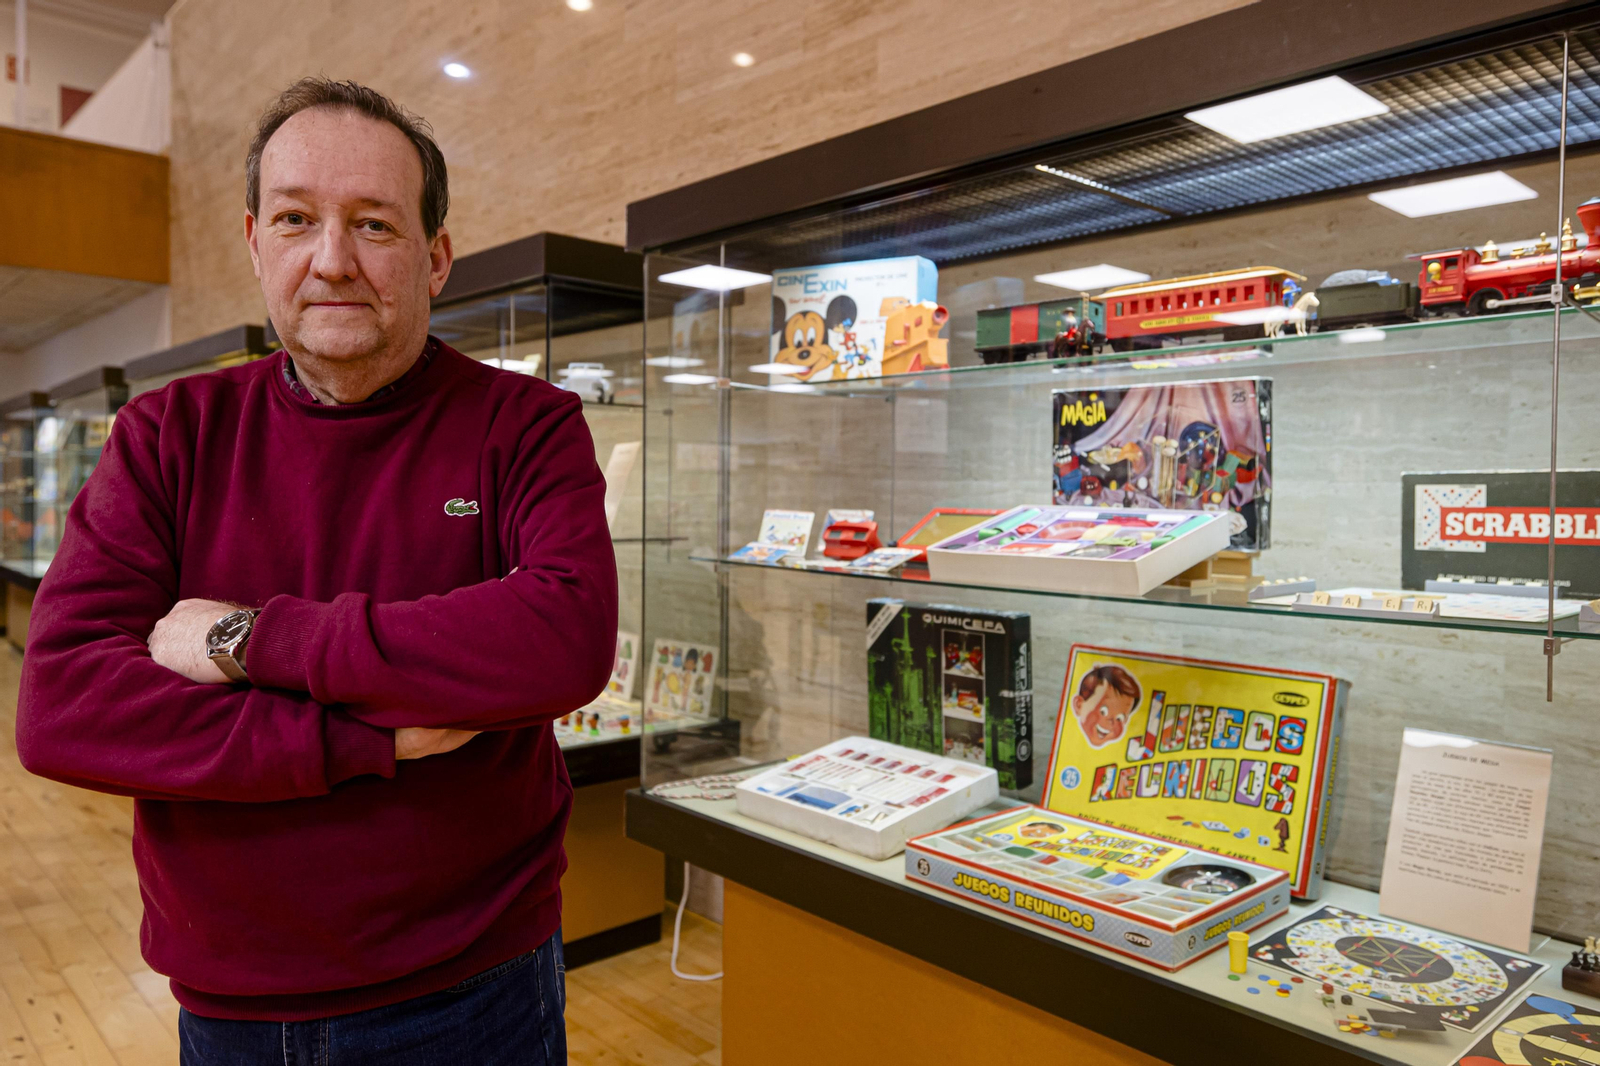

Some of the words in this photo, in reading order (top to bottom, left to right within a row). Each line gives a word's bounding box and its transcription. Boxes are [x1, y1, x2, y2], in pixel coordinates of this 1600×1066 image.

[922, 612, 1006, 635] QUIMICEFA
[1125, 689, 1308, 763] JUEGOS
[1089, 758, 1300, 815] REUNIDOS
[952, 872, 1010, 903] JUEGOS
[1014, 890, 1095, 932] REUNIDOS
